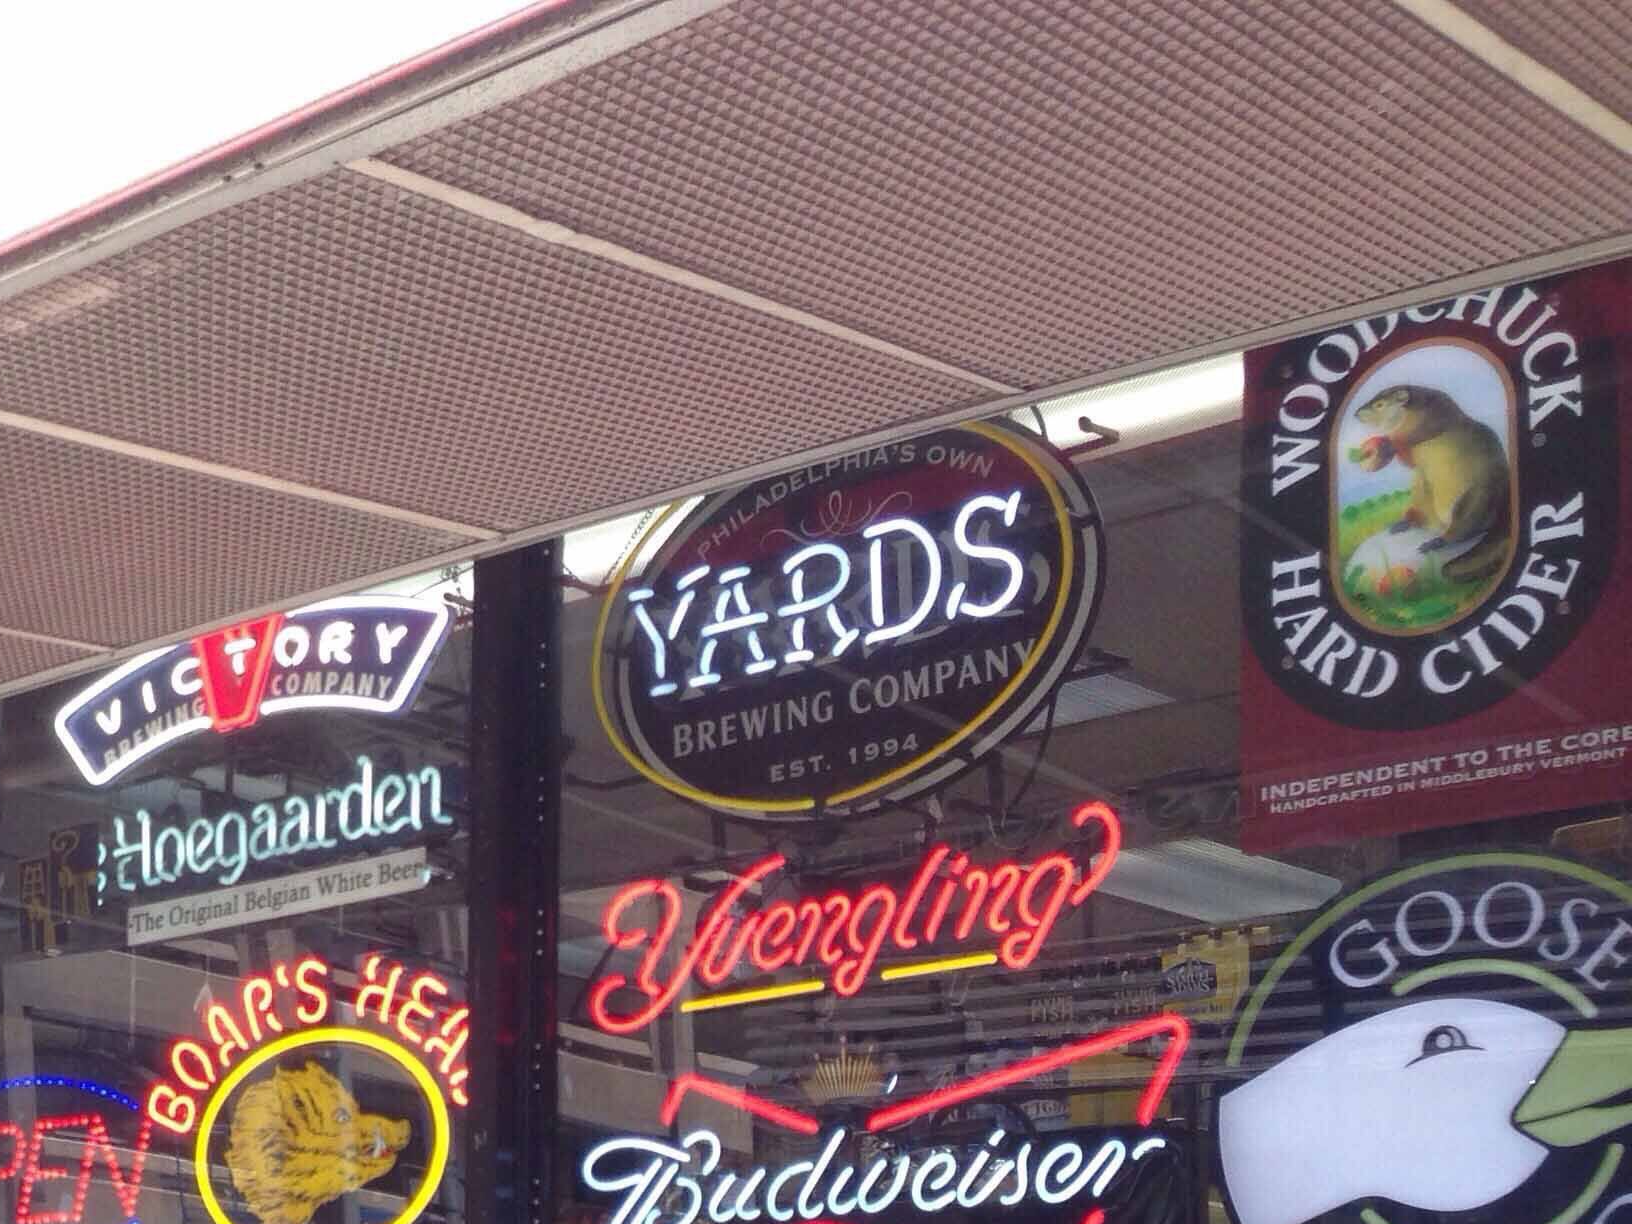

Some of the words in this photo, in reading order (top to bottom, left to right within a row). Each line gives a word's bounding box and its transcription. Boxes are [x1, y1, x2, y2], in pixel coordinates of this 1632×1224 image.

[926, 445, 995, 478] OWN
[629, 491, 1024, 697] YARDS
[1272, 551, 1399, 699] HARD
[1420, 492, 1584, 696] CIDER
[96, 621, 408, 735] VICTORY
[103, 699, 205, 769] BREWING
[271, 671, 393, 699] COMPANY
[672, 690, 833, 758] BREWING
[849, 638, 1037, 713] COMPANY
[770, 755, 832, 782] EST.
[848, 733, 920, 763] 1994
[1260, 756, 1447, 802] INDEPENDENT
[1452, 748, 1489, 767] TO
[1496, 739, 1551, 763] THE
[1269, 786, 1393, 814] HANDCRAFTED
[1398, 781, 1416, 793] IN
[1421, 761, 1536, 789] MIDDLEBURY
[1540, 748, 1626, 770] VERMONT
[114, 755, 453, 891] Hoegaarden
[132, 912, 165, 934] The
[169, 897, 239, 927] Original
[244, 884, 311, 915] Belgian
[315, 869, 372, 897] White
[377, 862, 423, 886] Beer
[592, 801, 1121, 1033] Yuengling
[1329, 880, 1632, 992] GOOSE
[147, 960, 330, 1133] BOAR'S
[355, 954, 469, 1106] HEA
